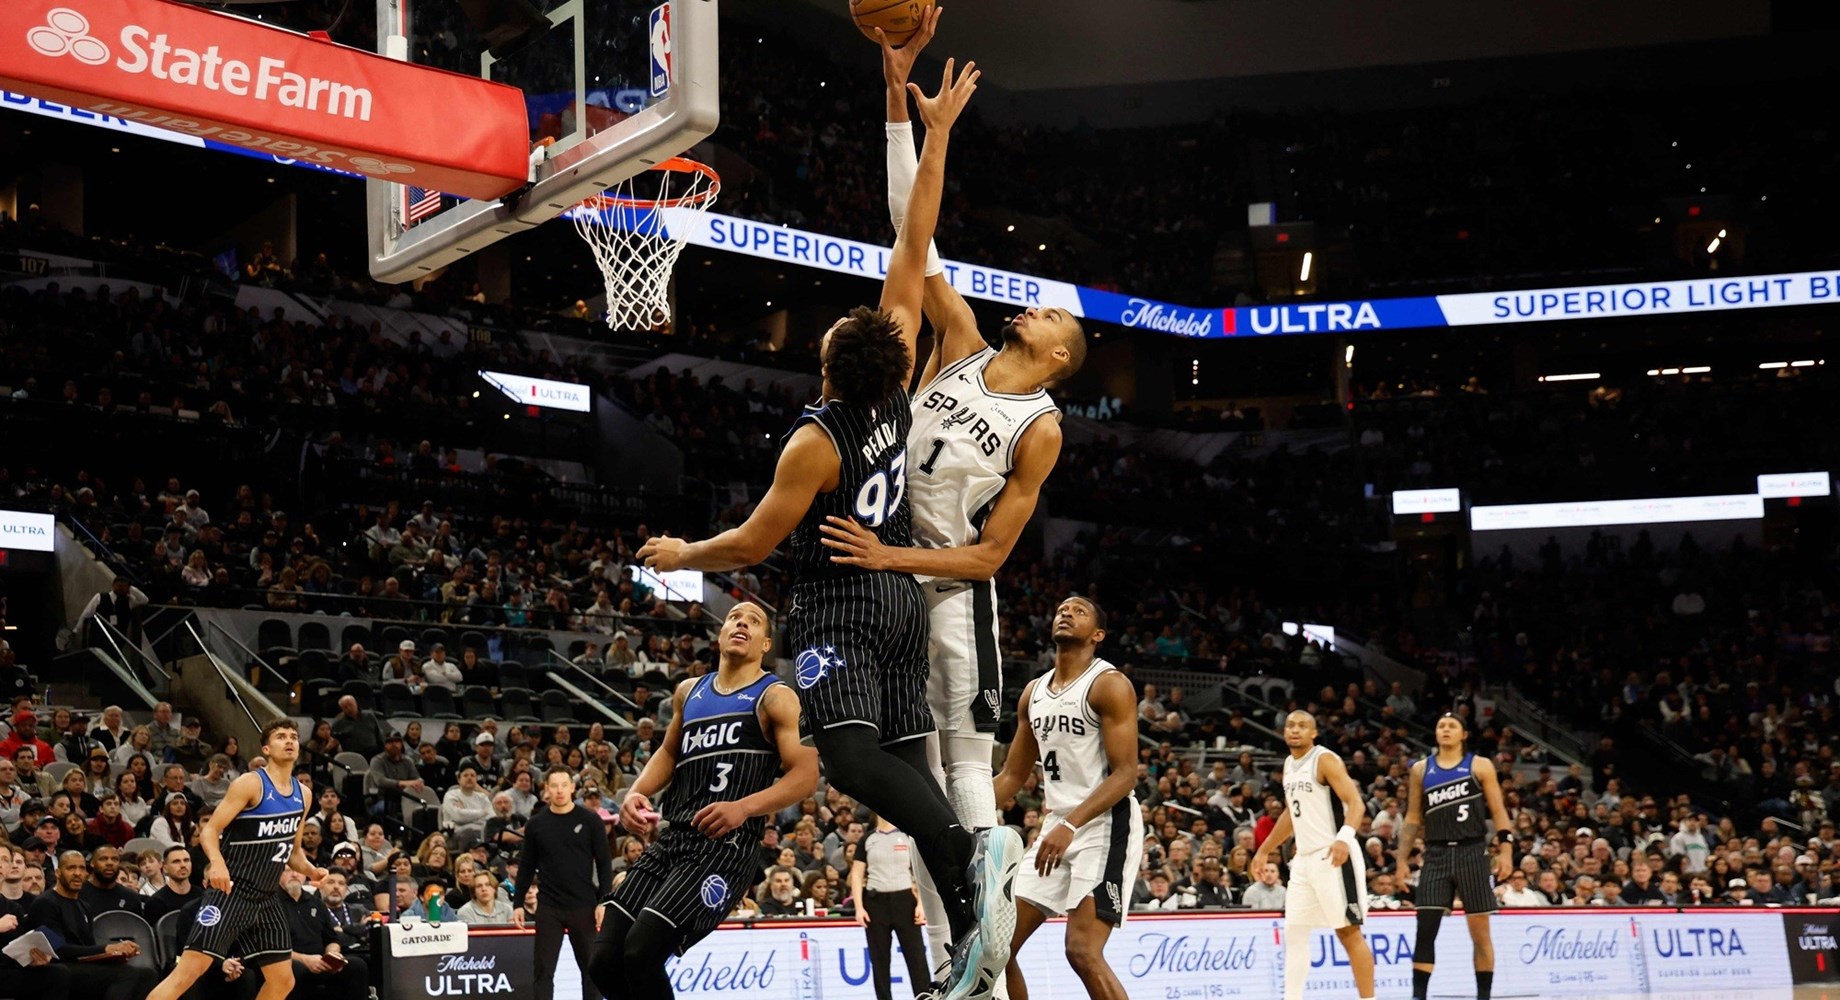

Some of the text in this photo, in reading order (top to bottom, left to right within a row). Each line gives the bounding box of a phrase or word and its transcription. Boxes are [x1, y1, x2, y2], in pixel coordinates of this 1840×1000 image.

[710, 219, 864, 271] SUPERIOR
[19, 257, 46, 275] 107
[972, 271, 1040, 304] BEER
[1493, 287, 1671, 318] SUPERIOR
[1688, 279, 1792, 306] LIGHT
[1121, 298, 1213, 337] Michelob
[1250, 302, 1381, 334] ULTRA
[540, 390, 580, 402] ULTRA
[923, 391, 1001, 457] SPURS
[918, 438, 947, 476] 1
[855, 450, 907, 528] 93
[3, 525, 45, 535] ULTRA
[709, 762, 733, 792] 3
[1043, 750, 1061, 782] 4
[1293, 800, 1301, 818] 3
[1456, 804, 1470, 822] 5
[401, 934, 451, 945] GATORADE
[1654, 928, 1746, 957] ULTRA
[1798, 936, 1839, 950] ULTRA
[437, 955, 495, 973] Michelob
[1129, 933, 1256, 978] Michelob
[425, 973, 512, 997] ULTRA
[664, 950, 775, 993] ichelob
